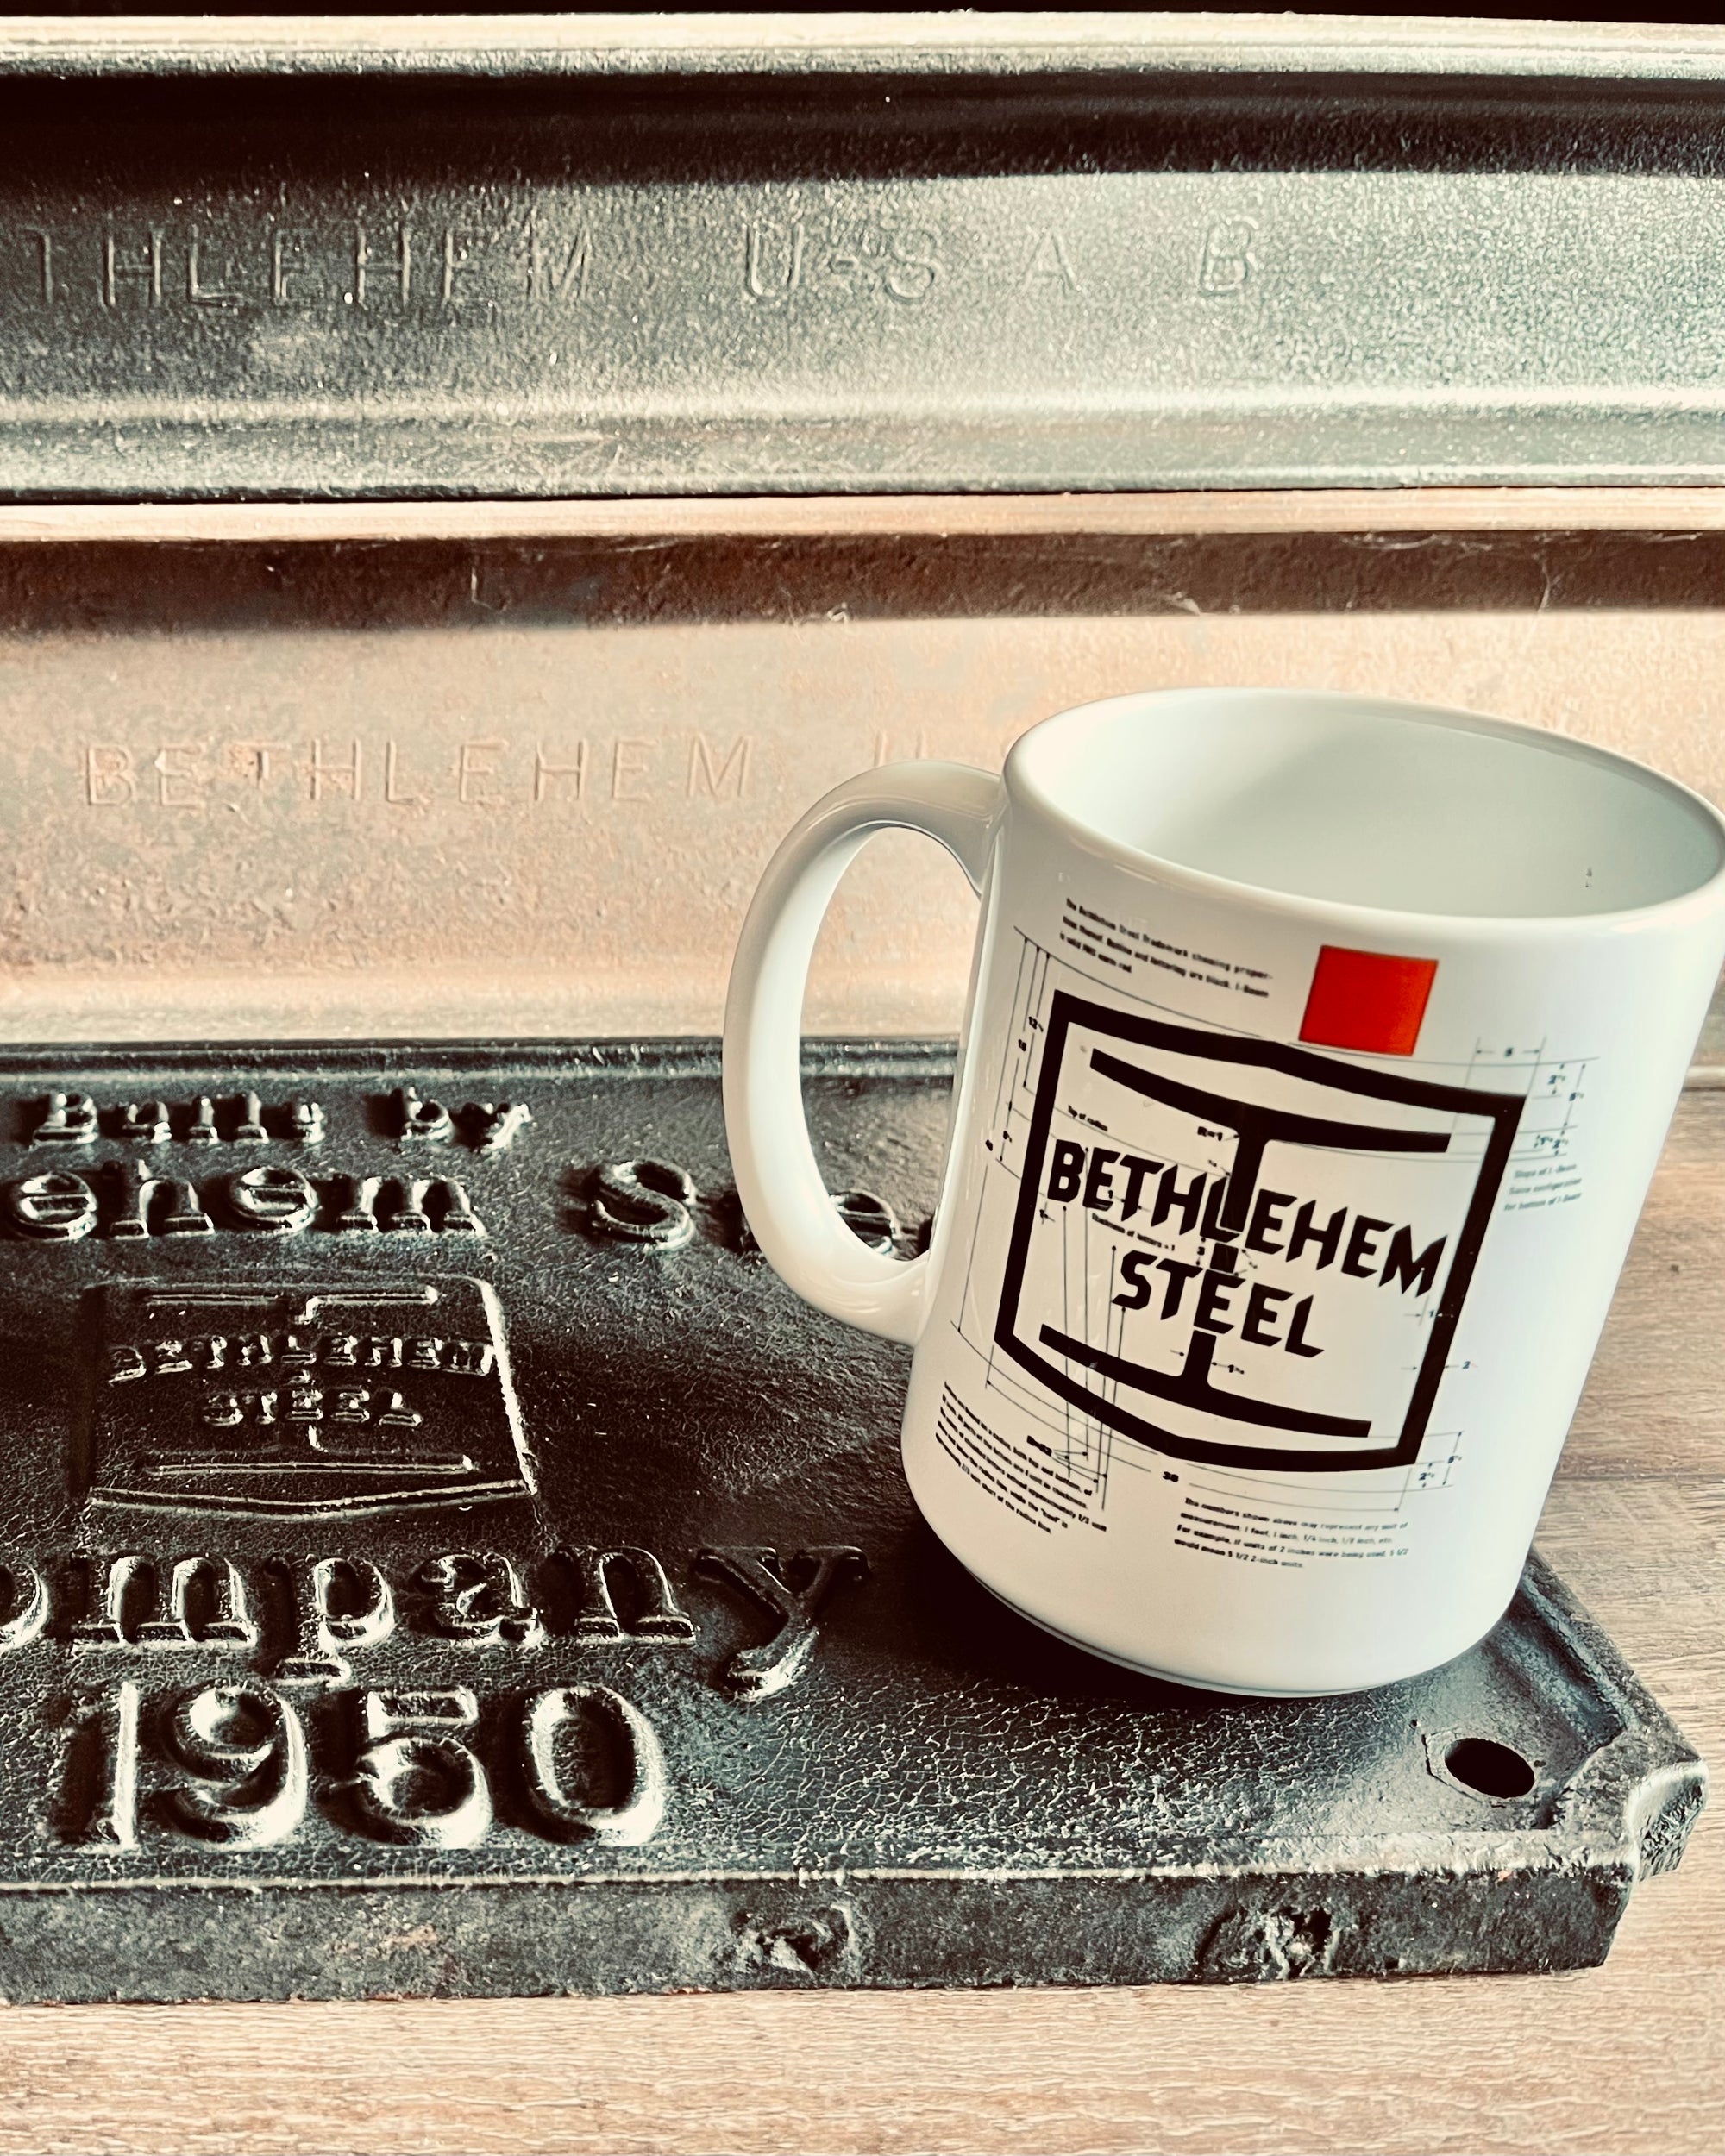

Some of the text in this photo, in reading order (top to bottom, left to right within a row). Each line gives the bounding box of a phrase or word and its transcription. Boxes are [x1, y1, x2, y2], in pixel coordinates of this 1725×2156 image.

[86, 733, 754, 807] BETHLEHEM
[31, 1088, 535, 1152] Built by
[14, 1164, 488, 1242] ehem
[1047, 1138, 1448, 1298] BETHLEHEM
[1112, 1250, 1325, 1358] STEEL
[108, 1333, 497, 1383] BETHLEHEM
[203, 1388, 423, 1427] STEEL
[1176, 1524, 1191, 1533] For
[1185, 1497, 1200, 1507] The
[1201, 1504, 1239, 1517] numbers
[1243, 1513, 1270, 1523] shown
[1272, 1518, 1297, 1526] above
[73, 1680, 671, 1848] 1950
